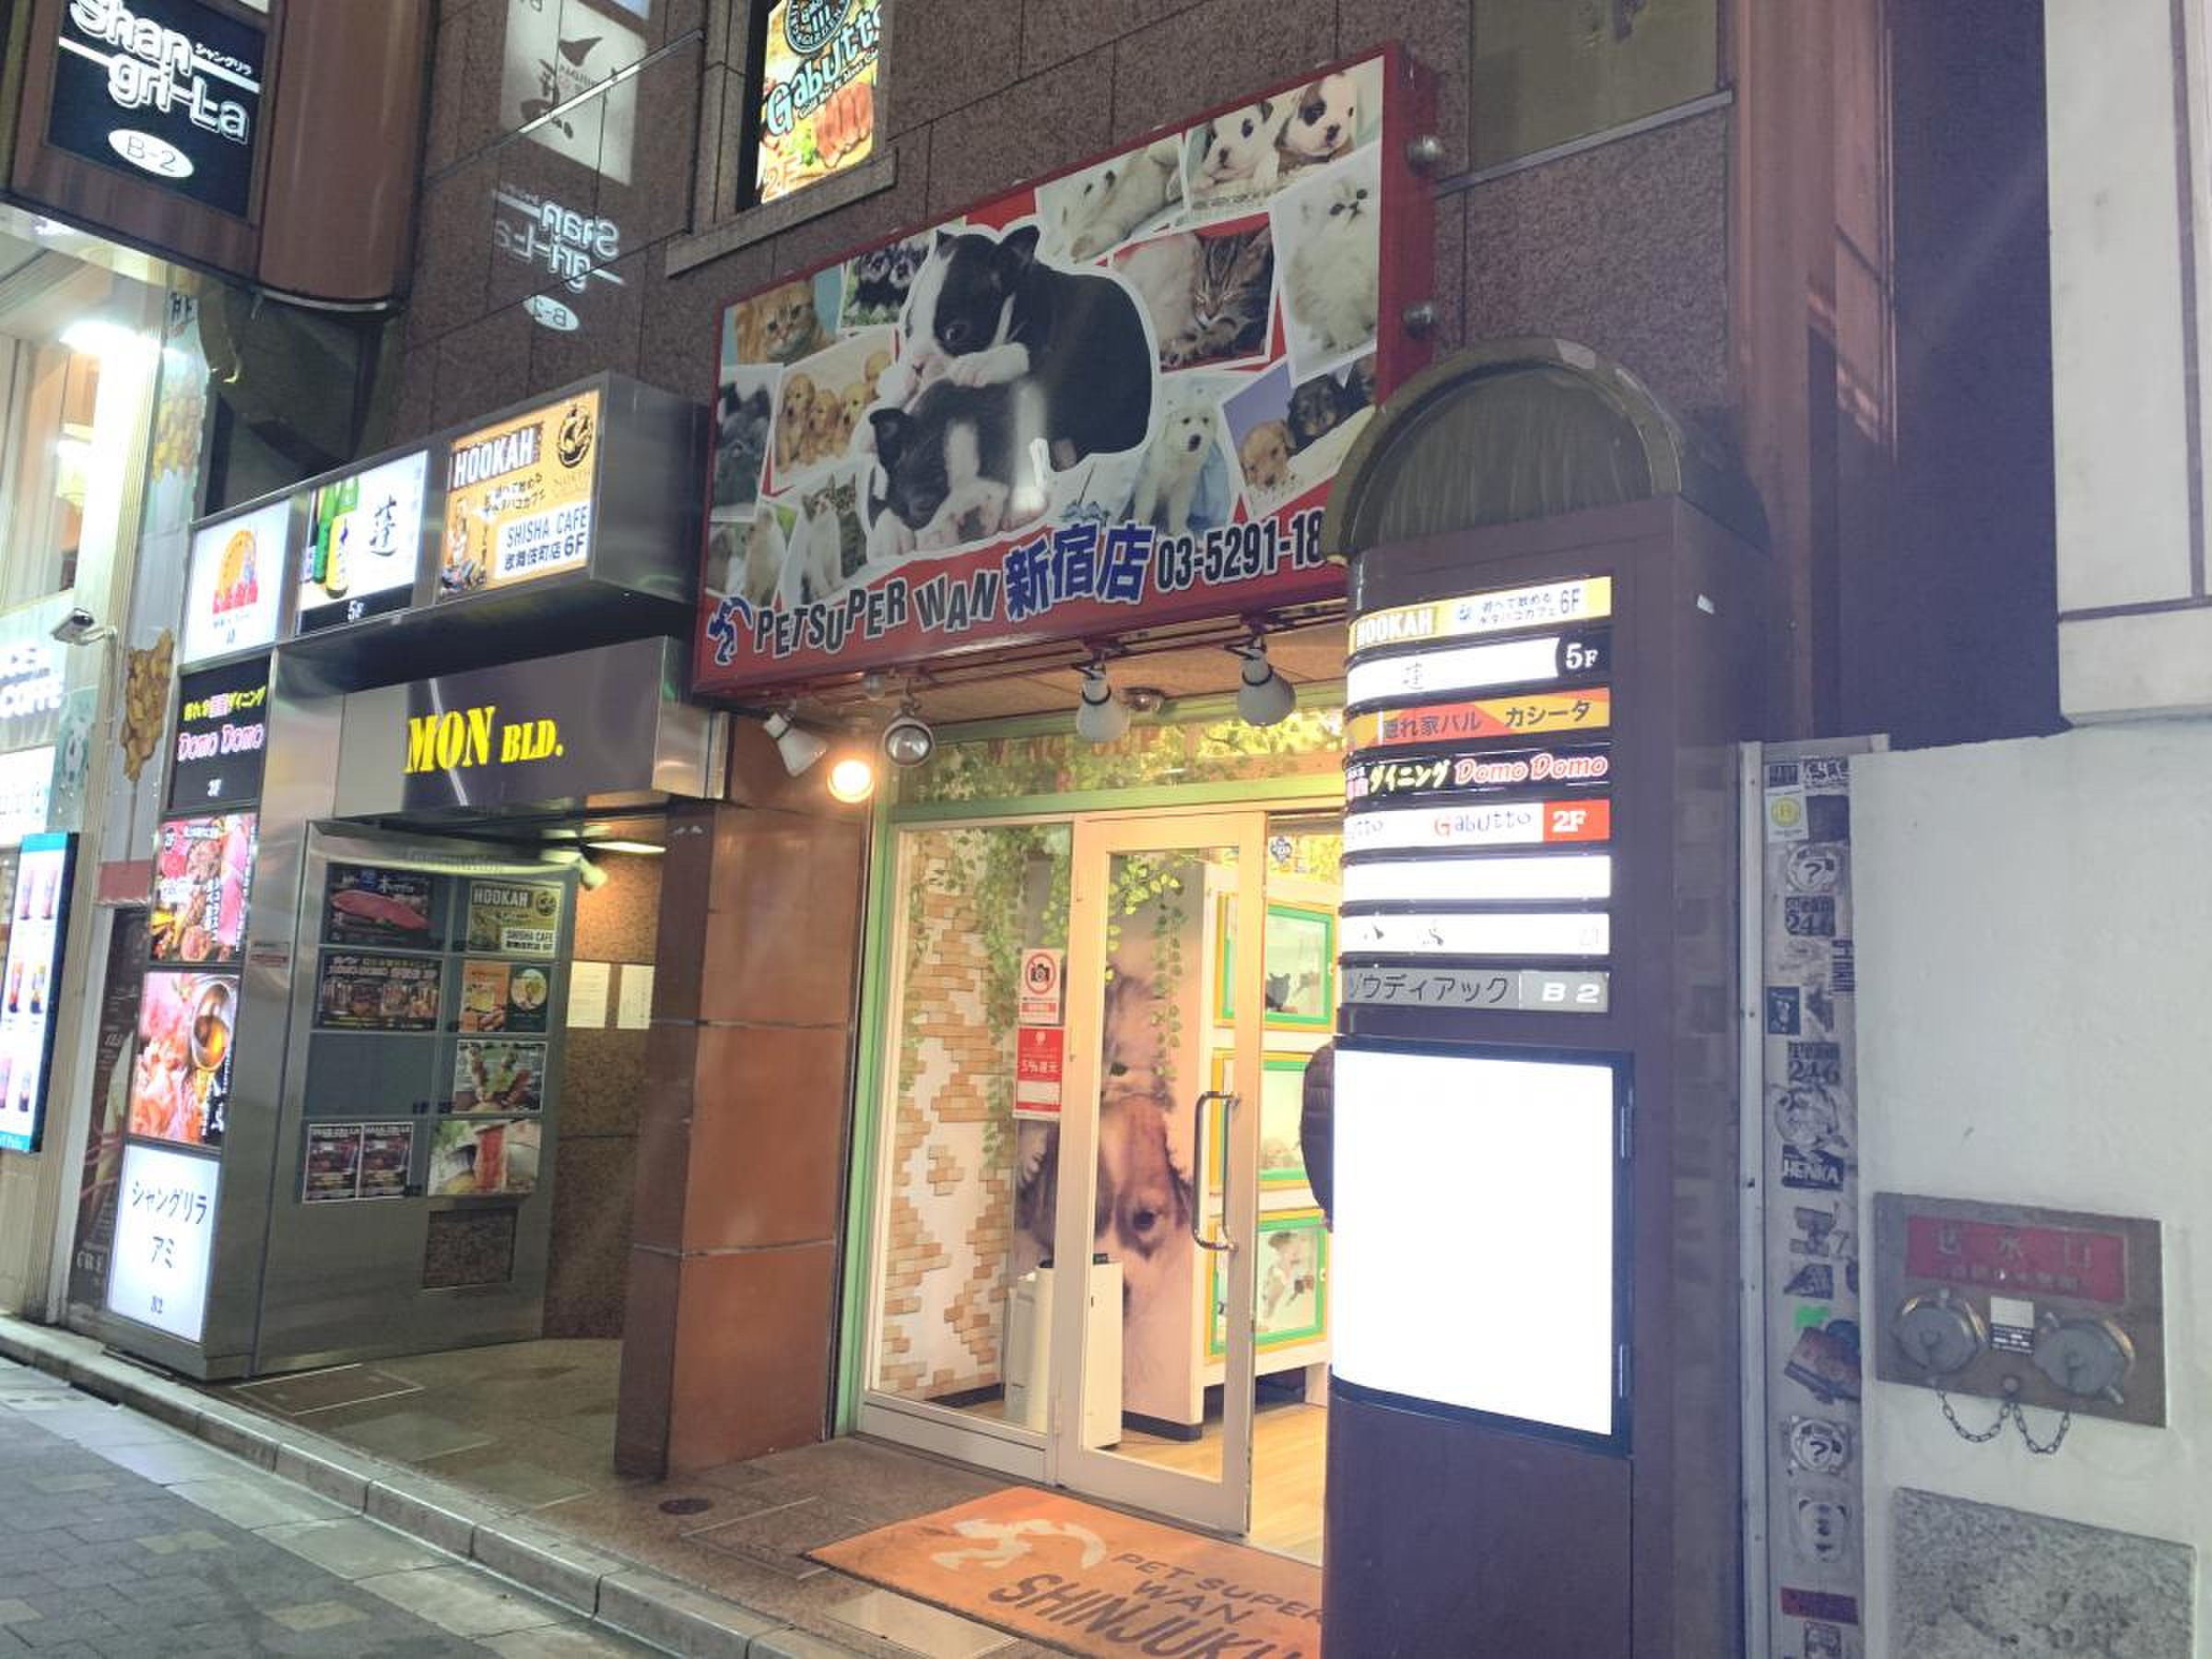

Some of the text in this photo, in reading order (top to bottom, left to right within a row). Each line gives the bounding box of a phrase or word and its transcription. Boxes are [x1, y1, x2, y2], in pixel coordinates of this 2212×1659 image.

[69, 0, 193, 76] Shan
[453, 427, 536, 488] HOOKAH
[506, 505, 588, 547] SHISHA CAFE
[563, 532, 586, 558] 6F
[1004, 507, 1327, 622] 新宿店 03-5291-18
[913, 569, 1002, 633] WAN
[1560, 587, 1582, 615] 6F
[1565, 642, 1599, 669] 5F
[1504, 700, 1592, 728] カシータ
[401, 705, 564, 774] MON BLD.
[1369, 759, 1451, 793] ダイニング
[1454, 758, 1528, 784] Domo
[1530, 753, 1609, 781] Domo
[1551, 810, 1588, 832] 2F
[474, 888, 529, 907] HOOKAH
[132, 1181, 207, 1225] シャングリラ
[151, 1235, 175, 1269] アミ
[1111, 1553, 1194, 1579] PET
[988, 1572, 1304, 1659] SHINJUK
[1133, 1580, 1254, 1624] WAN
